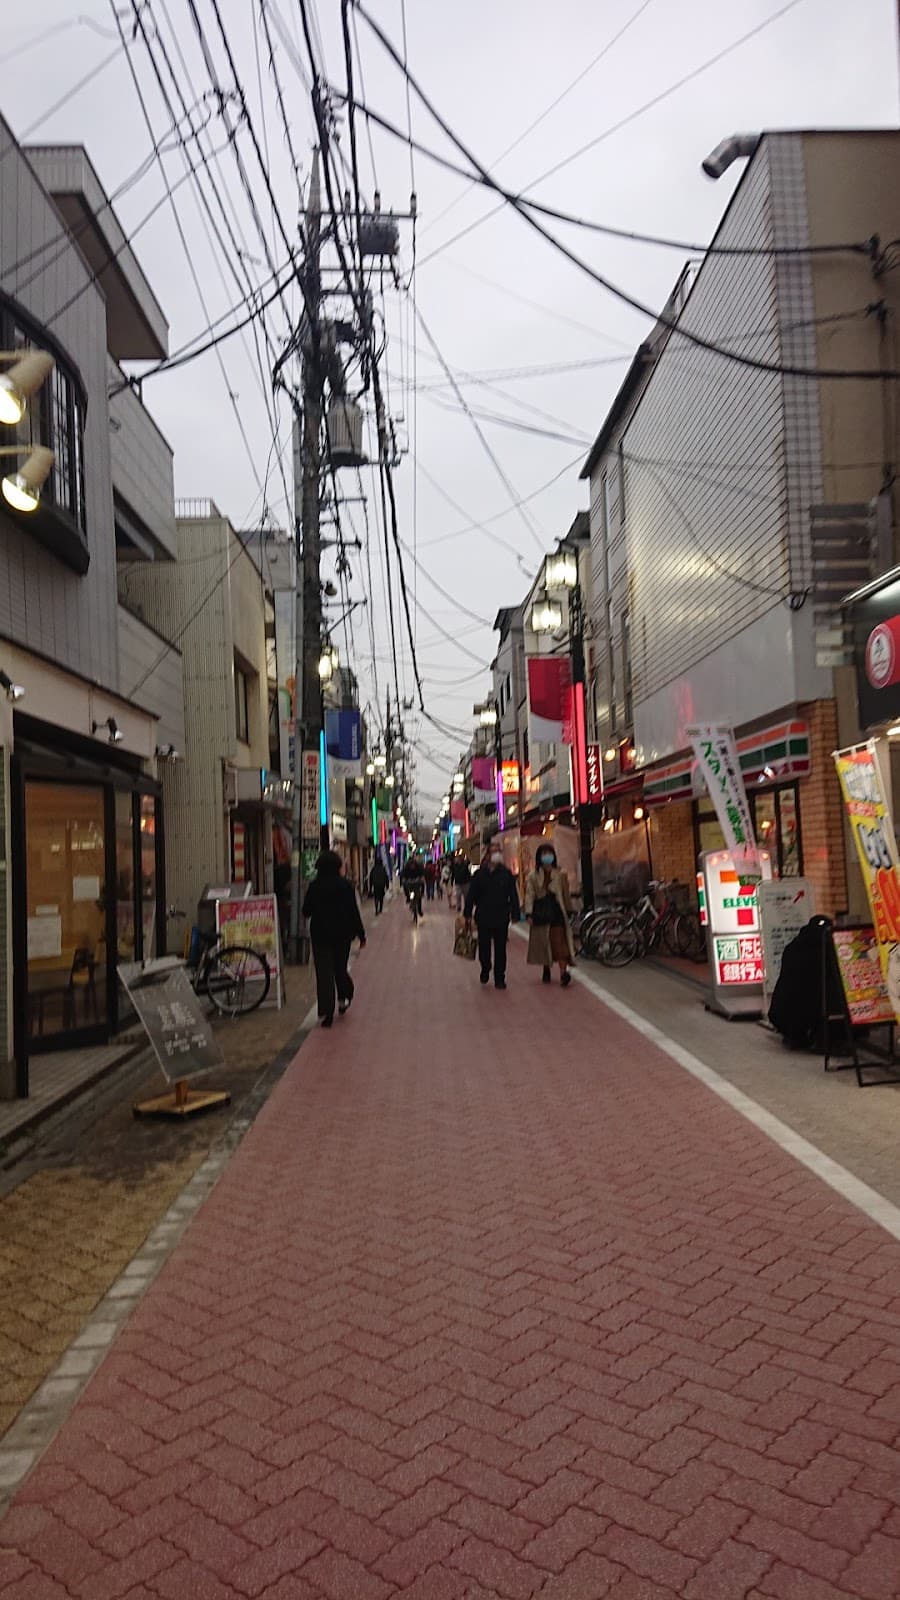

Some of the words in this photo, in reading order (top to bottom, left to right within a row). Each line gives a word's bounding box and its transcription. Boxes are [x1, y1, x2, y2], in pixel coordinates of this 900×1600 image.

[586, 747, 600, 795] リサイクル
[723, 897, 758, 909] ELEVE
